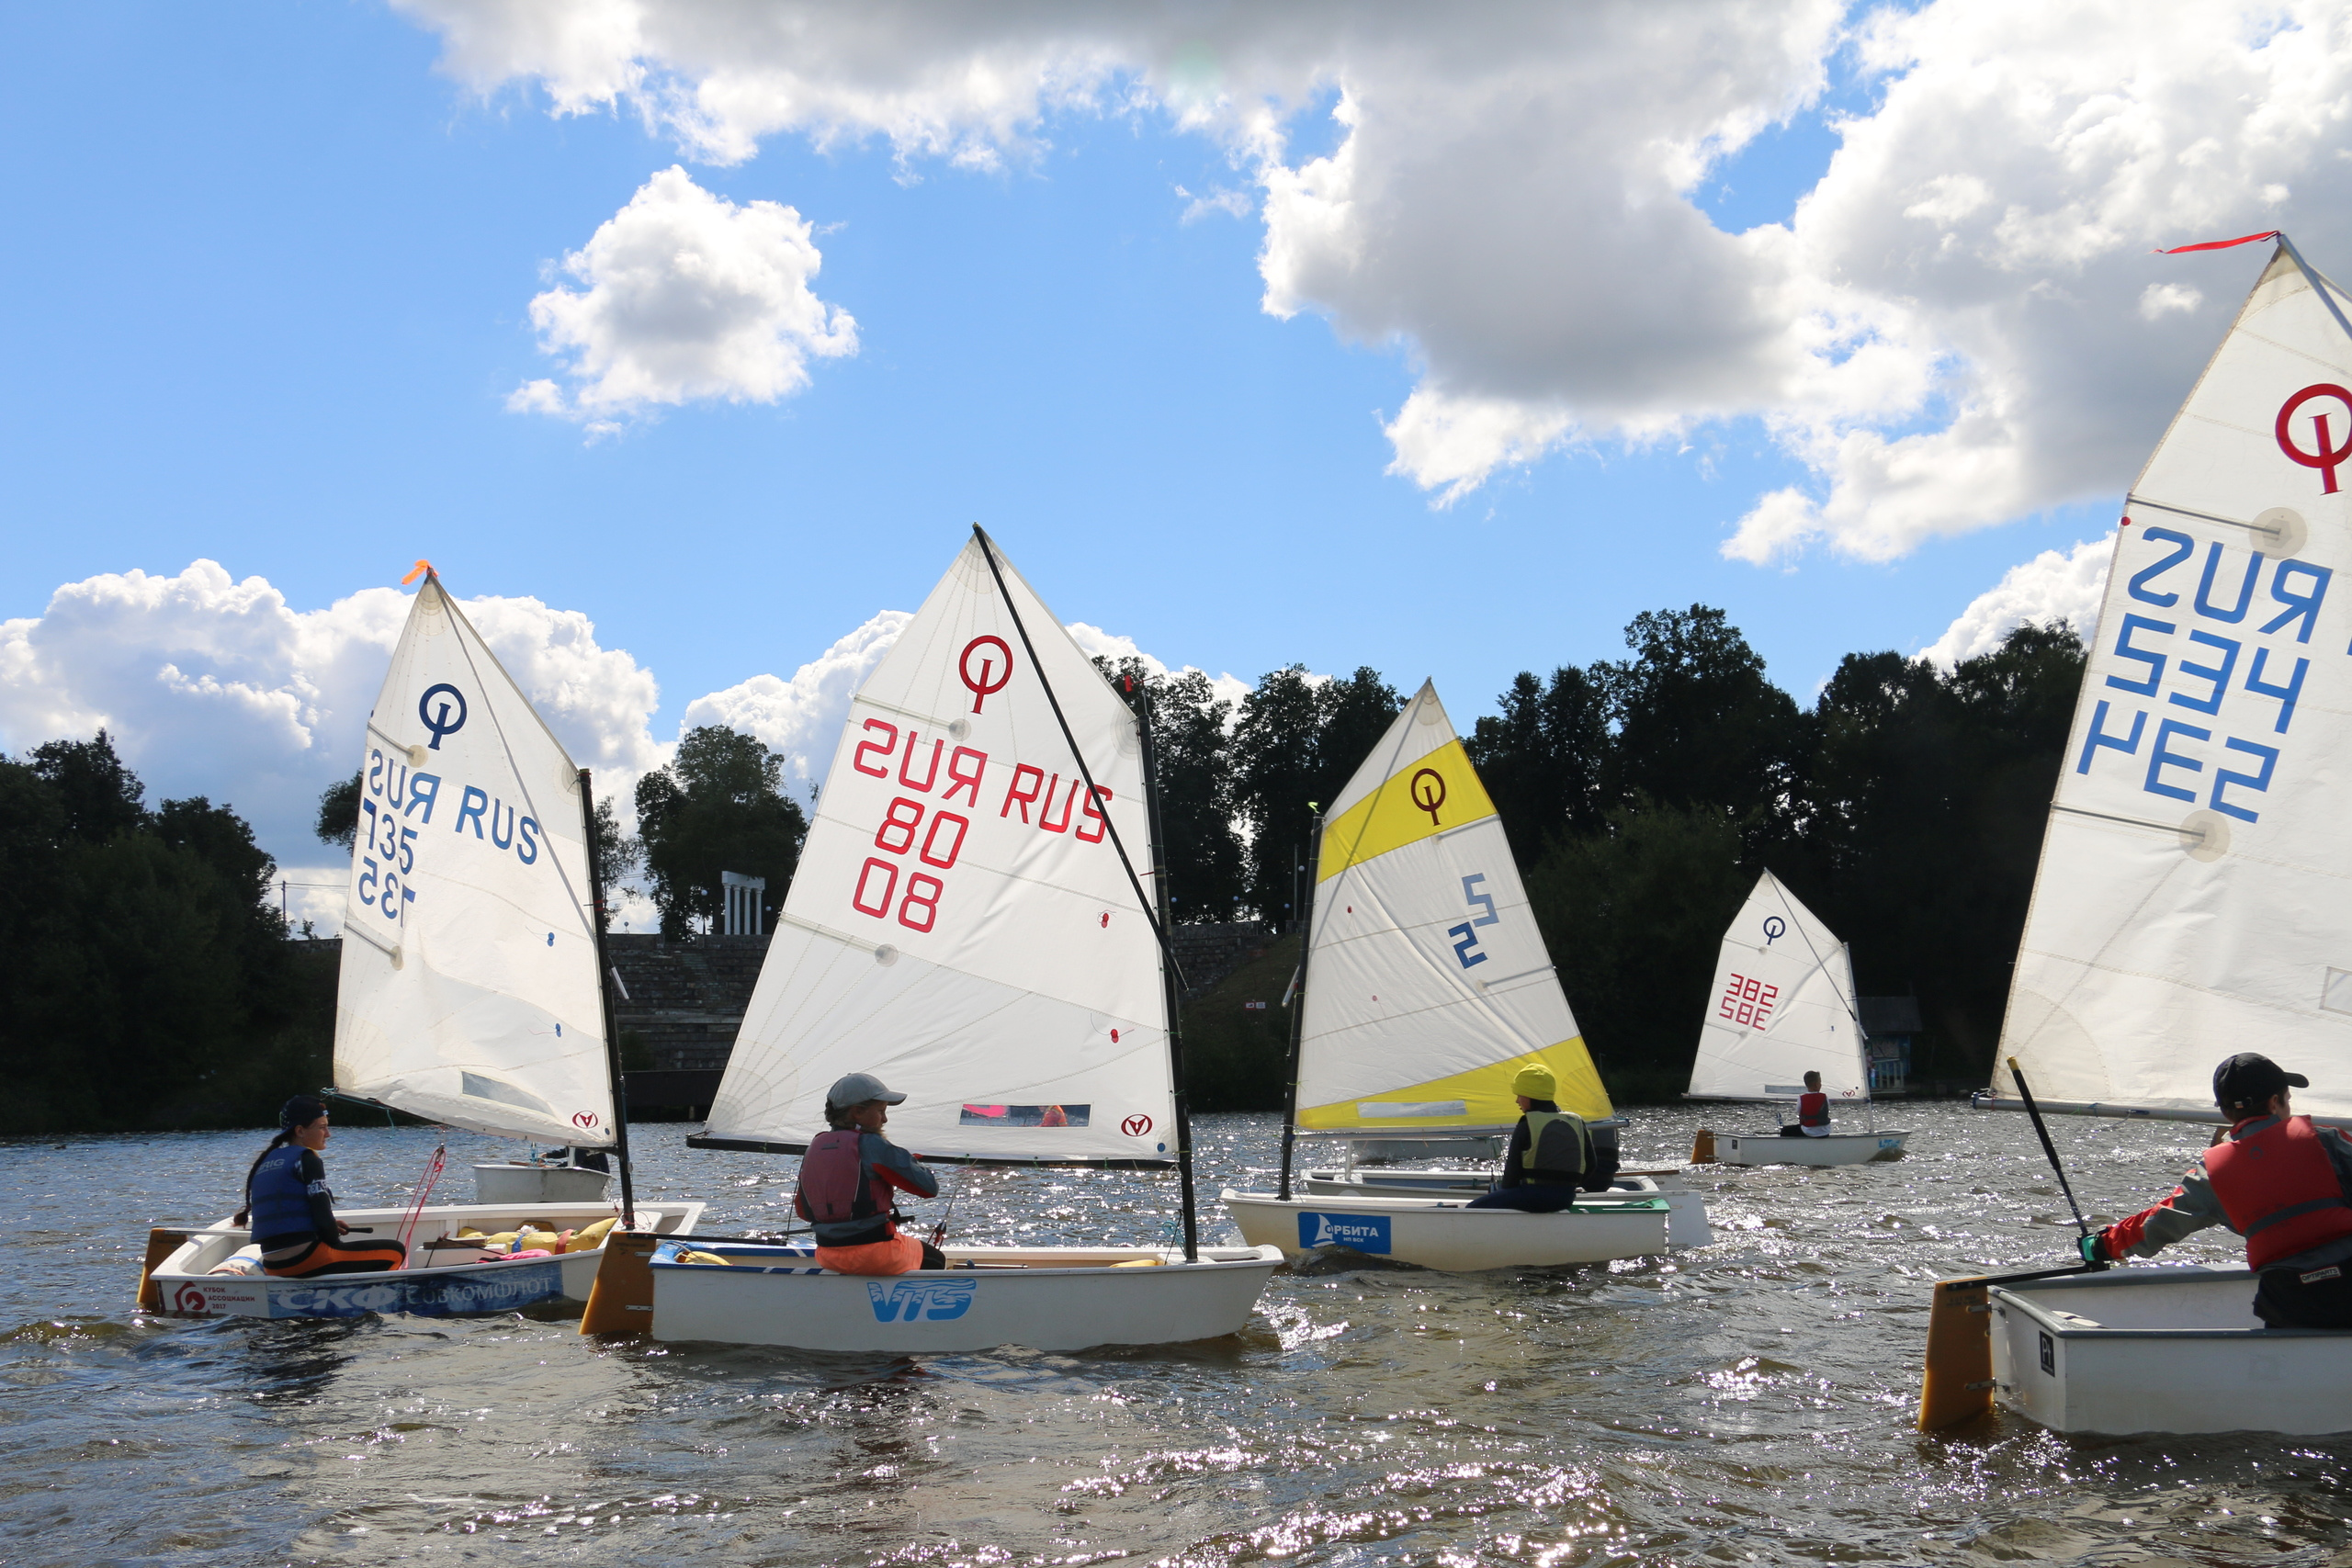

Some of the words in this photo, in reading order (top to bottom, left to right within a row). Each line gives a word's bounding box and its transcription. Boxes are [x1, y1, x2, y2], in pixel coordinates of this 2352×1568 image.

[2105, 613, 2310, 734] 534
[363, 797, 418, 875] 735
[456, 785, 539, 865] RUS
[875, 797, 969, 869] 80
[1001, 763, 1113, 844] RUS
[1448, 922, 1488, 969] 2
[1726, 973, 1779, 1008] 382
[1325, 1224, 1378, 1236] ОРБИТА
[277, 1285, 398, 1310] СКФ
